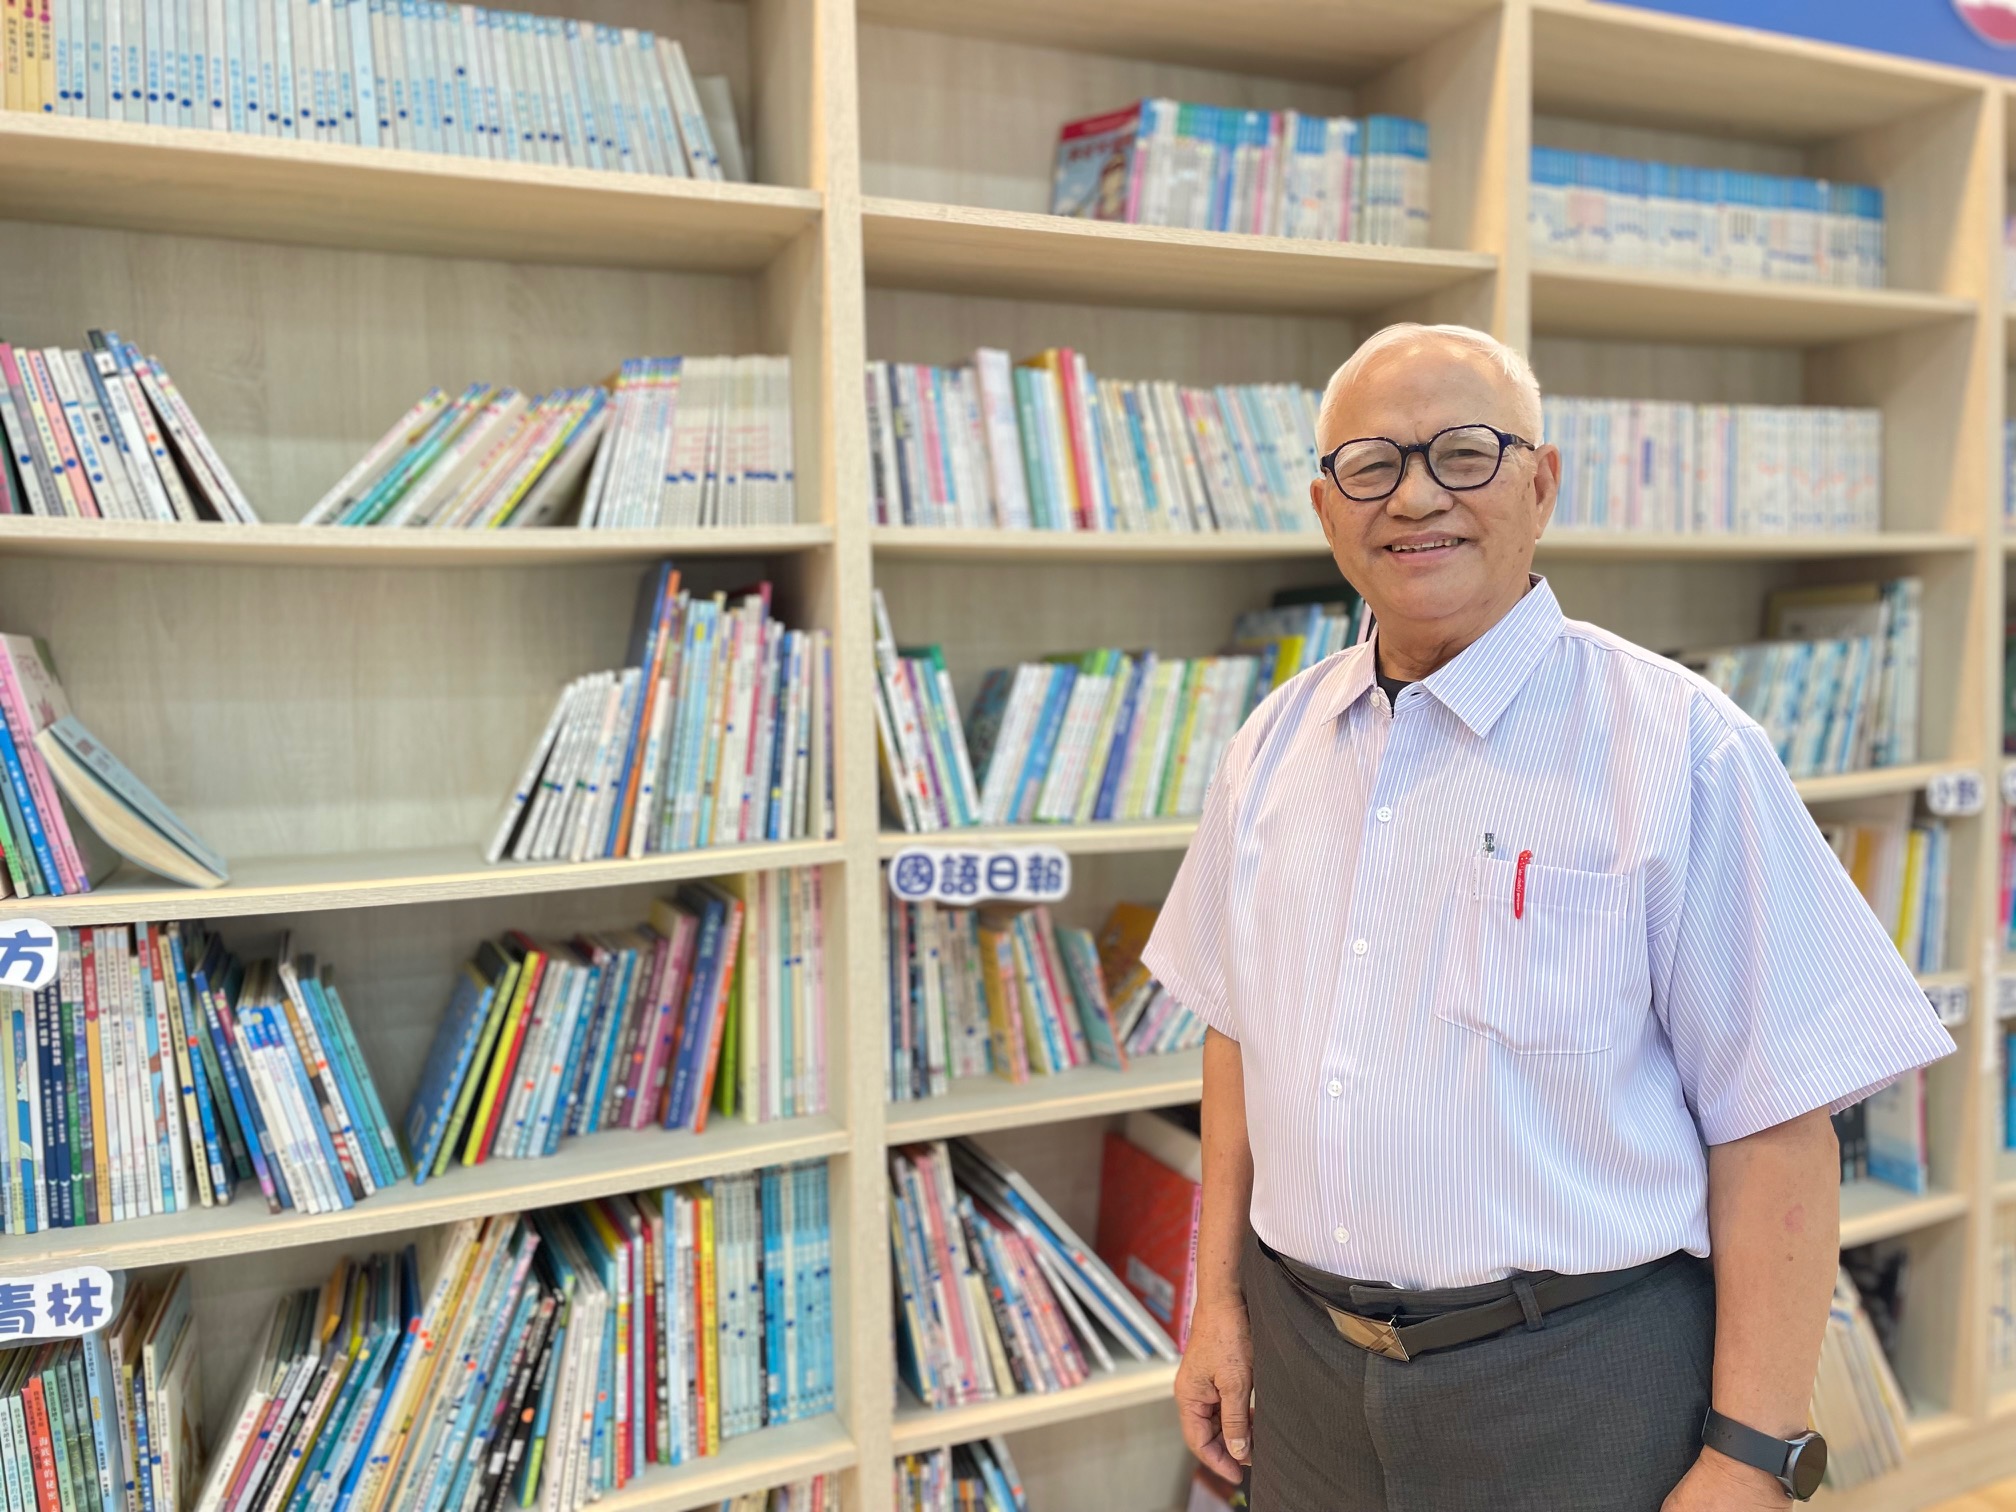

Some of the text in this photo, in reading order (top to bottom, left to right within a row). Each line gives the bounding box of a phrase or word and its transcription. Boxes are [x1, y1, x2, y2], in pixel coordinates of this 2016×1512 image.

[897, 854, 1063, 896] 國語日報
[0, 929, 53, 983] 方
[0, 1278, 103, 1335] 青林
